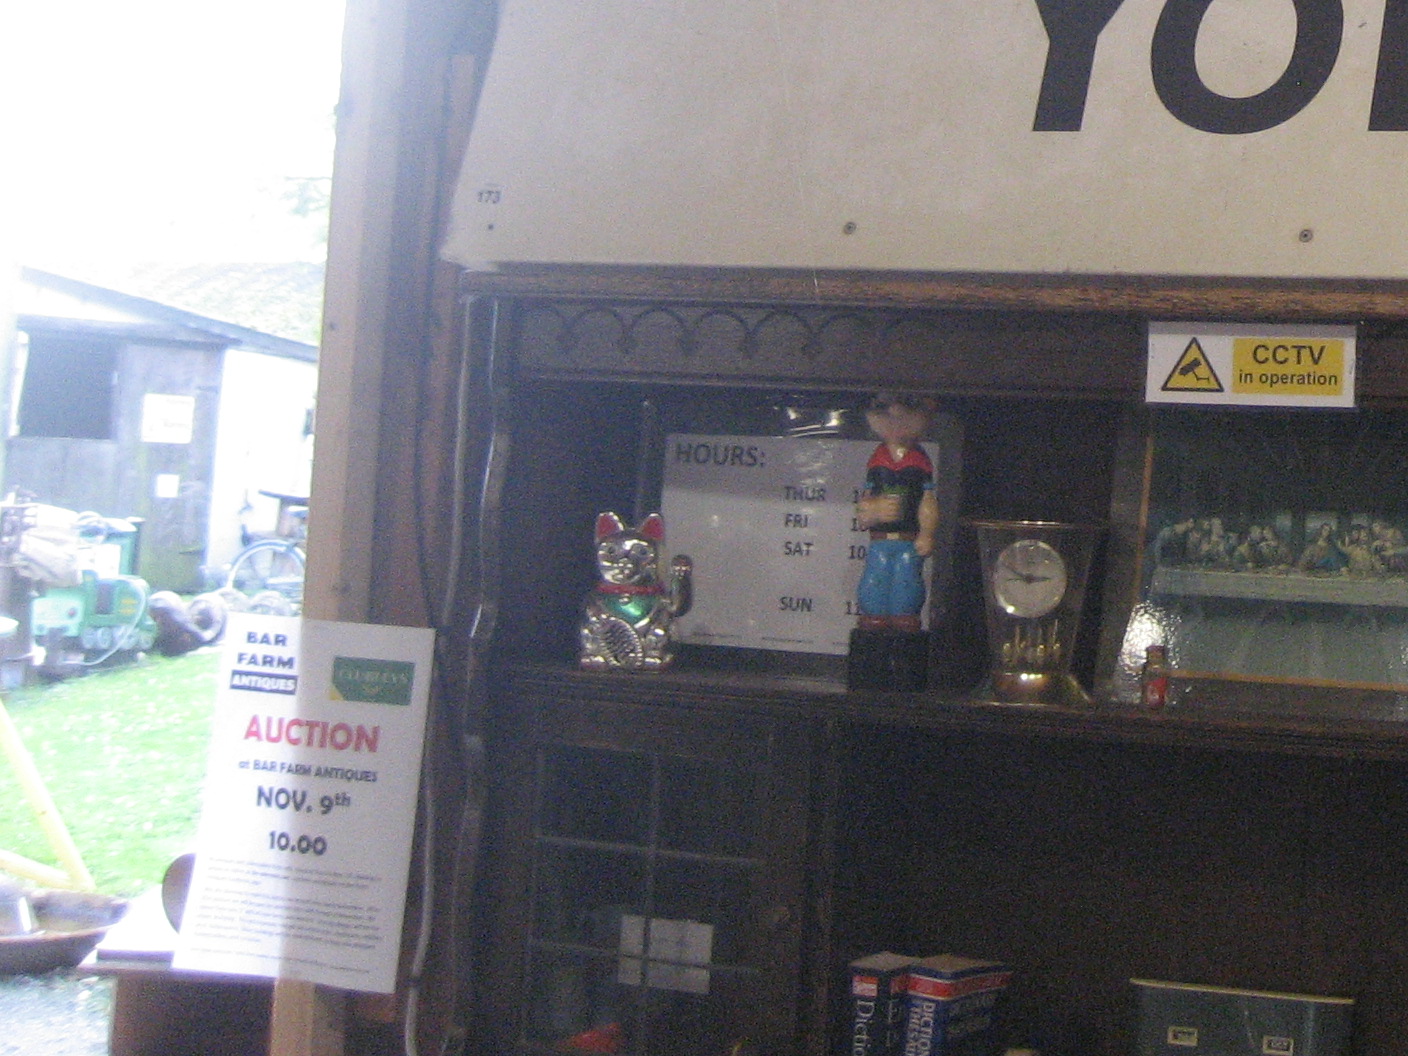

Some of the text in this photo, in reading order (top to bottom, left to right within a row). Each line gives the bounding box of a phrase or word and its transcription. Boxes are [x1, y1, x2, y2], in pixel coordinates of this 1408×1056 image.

[1252, 344, 1327, 366] CCTV
[1239, 370, 1338, 388] in operation
[675, 443, 766, 467] HOURS:
[784, 485, 827, 502] THUR
[784, 513, 809, 529] FRI
[784, 542, 814, 557] SAT
[779, 596, 813, 613] SUN
[246, 631, 288, 647] BAR
[237, 651, 296, 669] FARM
[231, 673, 296, 692] ANTIQUES
[243, 714, 381, 753] AUCTION
[253, 759, 278, 772] BAR
[280, 762, 312, 776] FARM
[314, 766, 378, 783] ANTIQUES
[256, 785, 352, 815] NOV. 9th
[269, 830, 328, 856] 10.00
